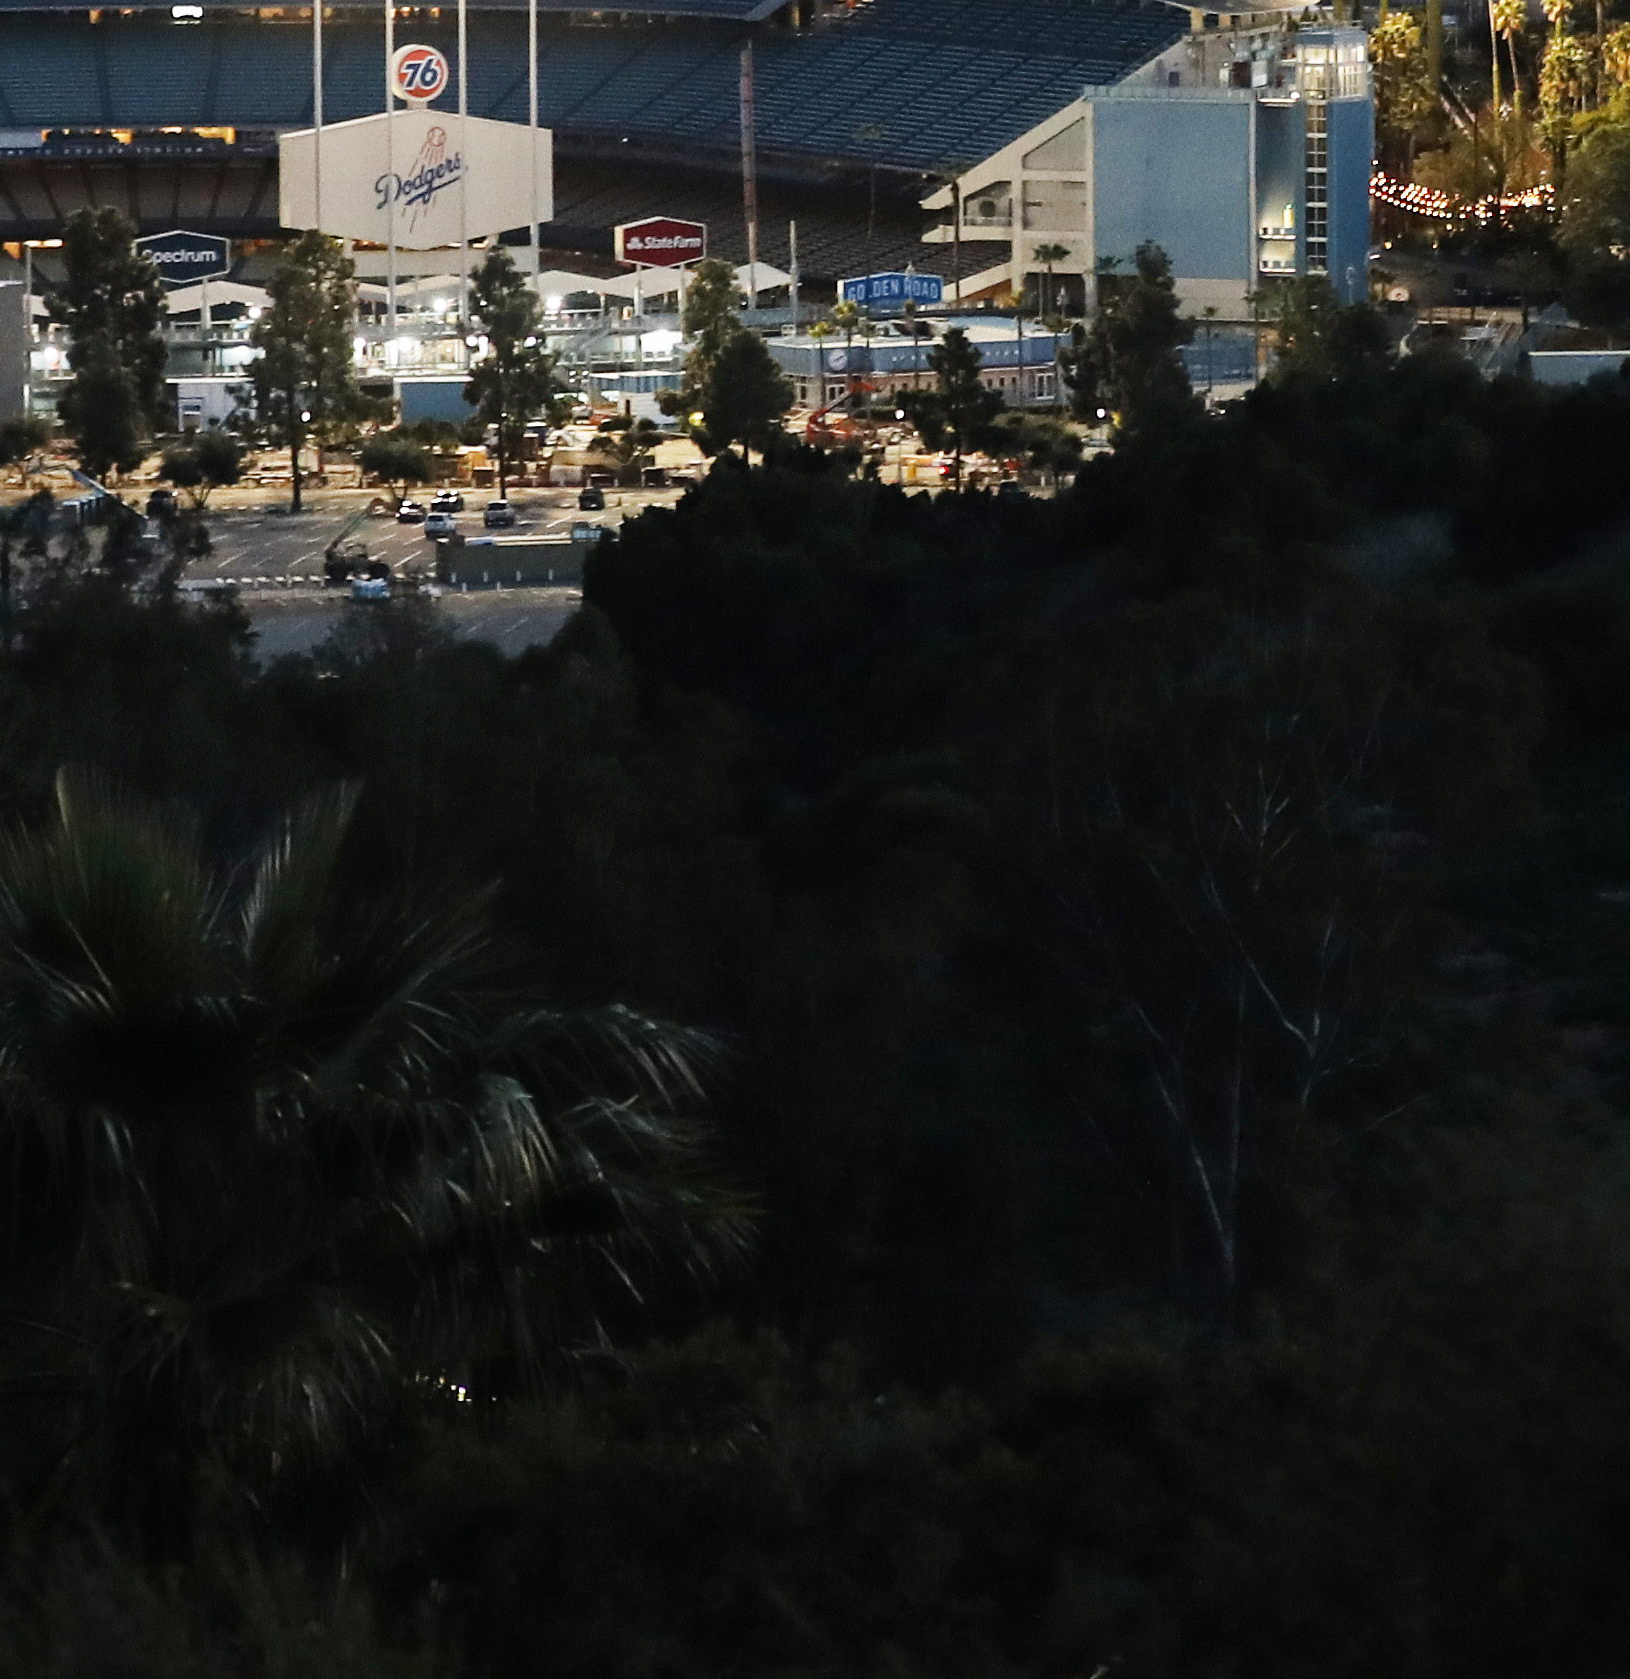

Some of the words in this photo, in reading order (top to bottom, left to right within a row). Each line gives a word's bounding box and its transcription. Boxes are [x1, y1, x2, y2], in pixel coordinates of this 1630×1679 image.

[403, 56, 439, 88] 76
[375, 153, 468, 210] Dodgers
[847, 279, 899, 301] GODEN
